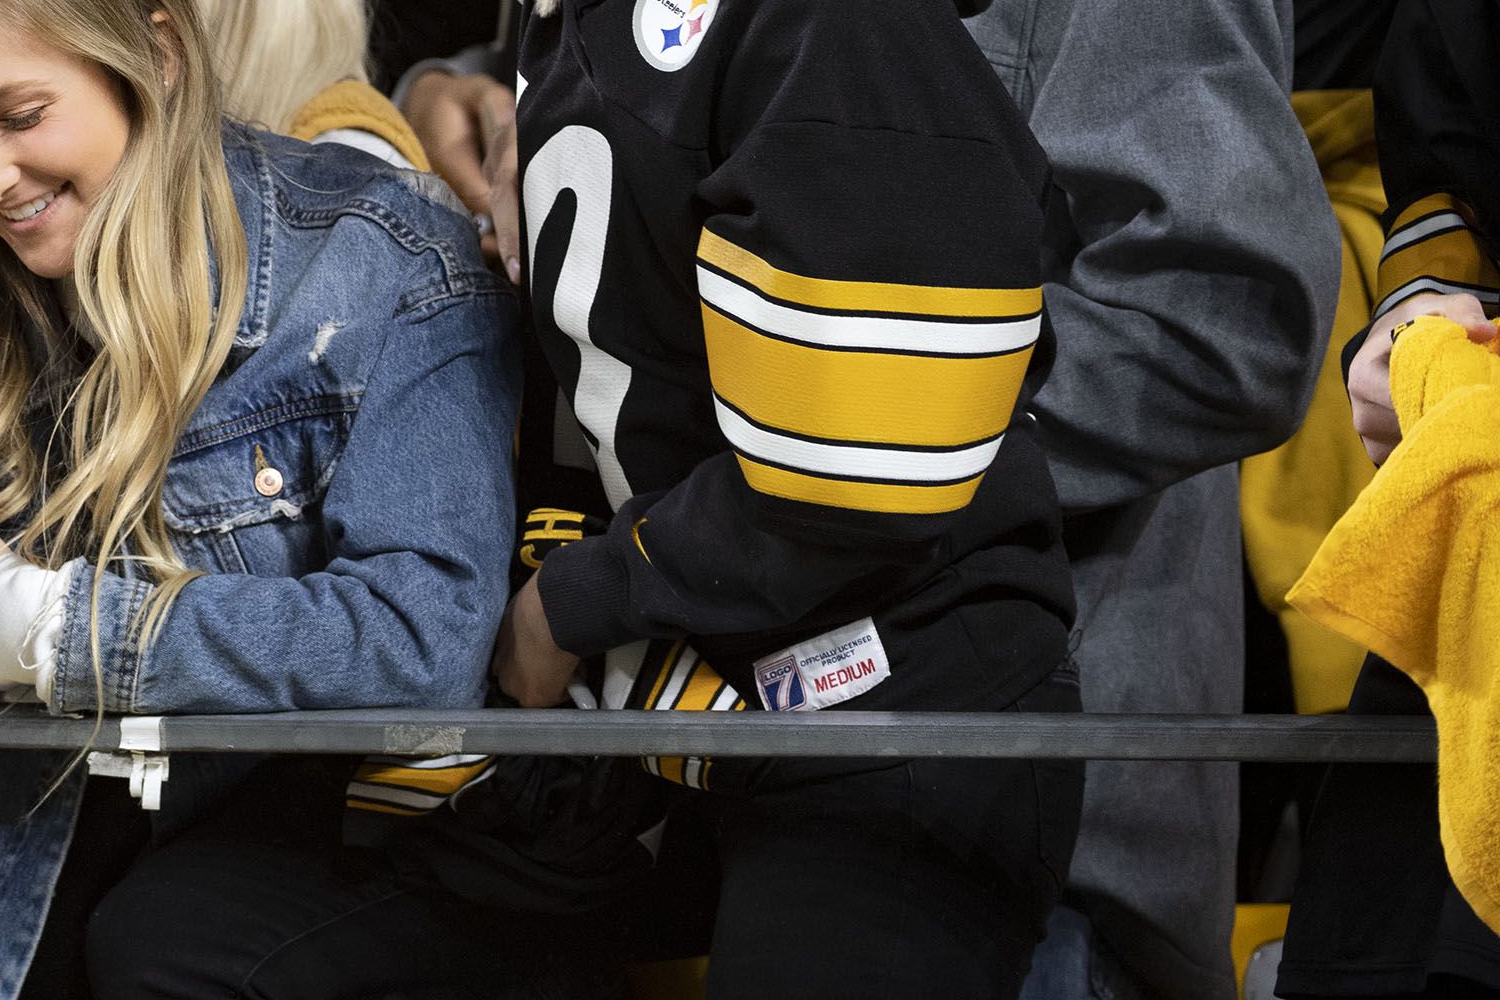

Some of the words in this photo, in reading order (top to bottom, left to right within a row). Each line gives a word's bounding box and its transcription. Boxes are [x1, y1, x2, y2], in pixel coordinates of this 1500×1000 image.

[800, 647, 837, 667] OFFICIALLY
[839, 634, 873, 654] LICENSED
[821, 649, 856, 667] PRODUCT
[764, 665, 792, 681] LOGO
[813, 658, 877, 693] MEDIUM
